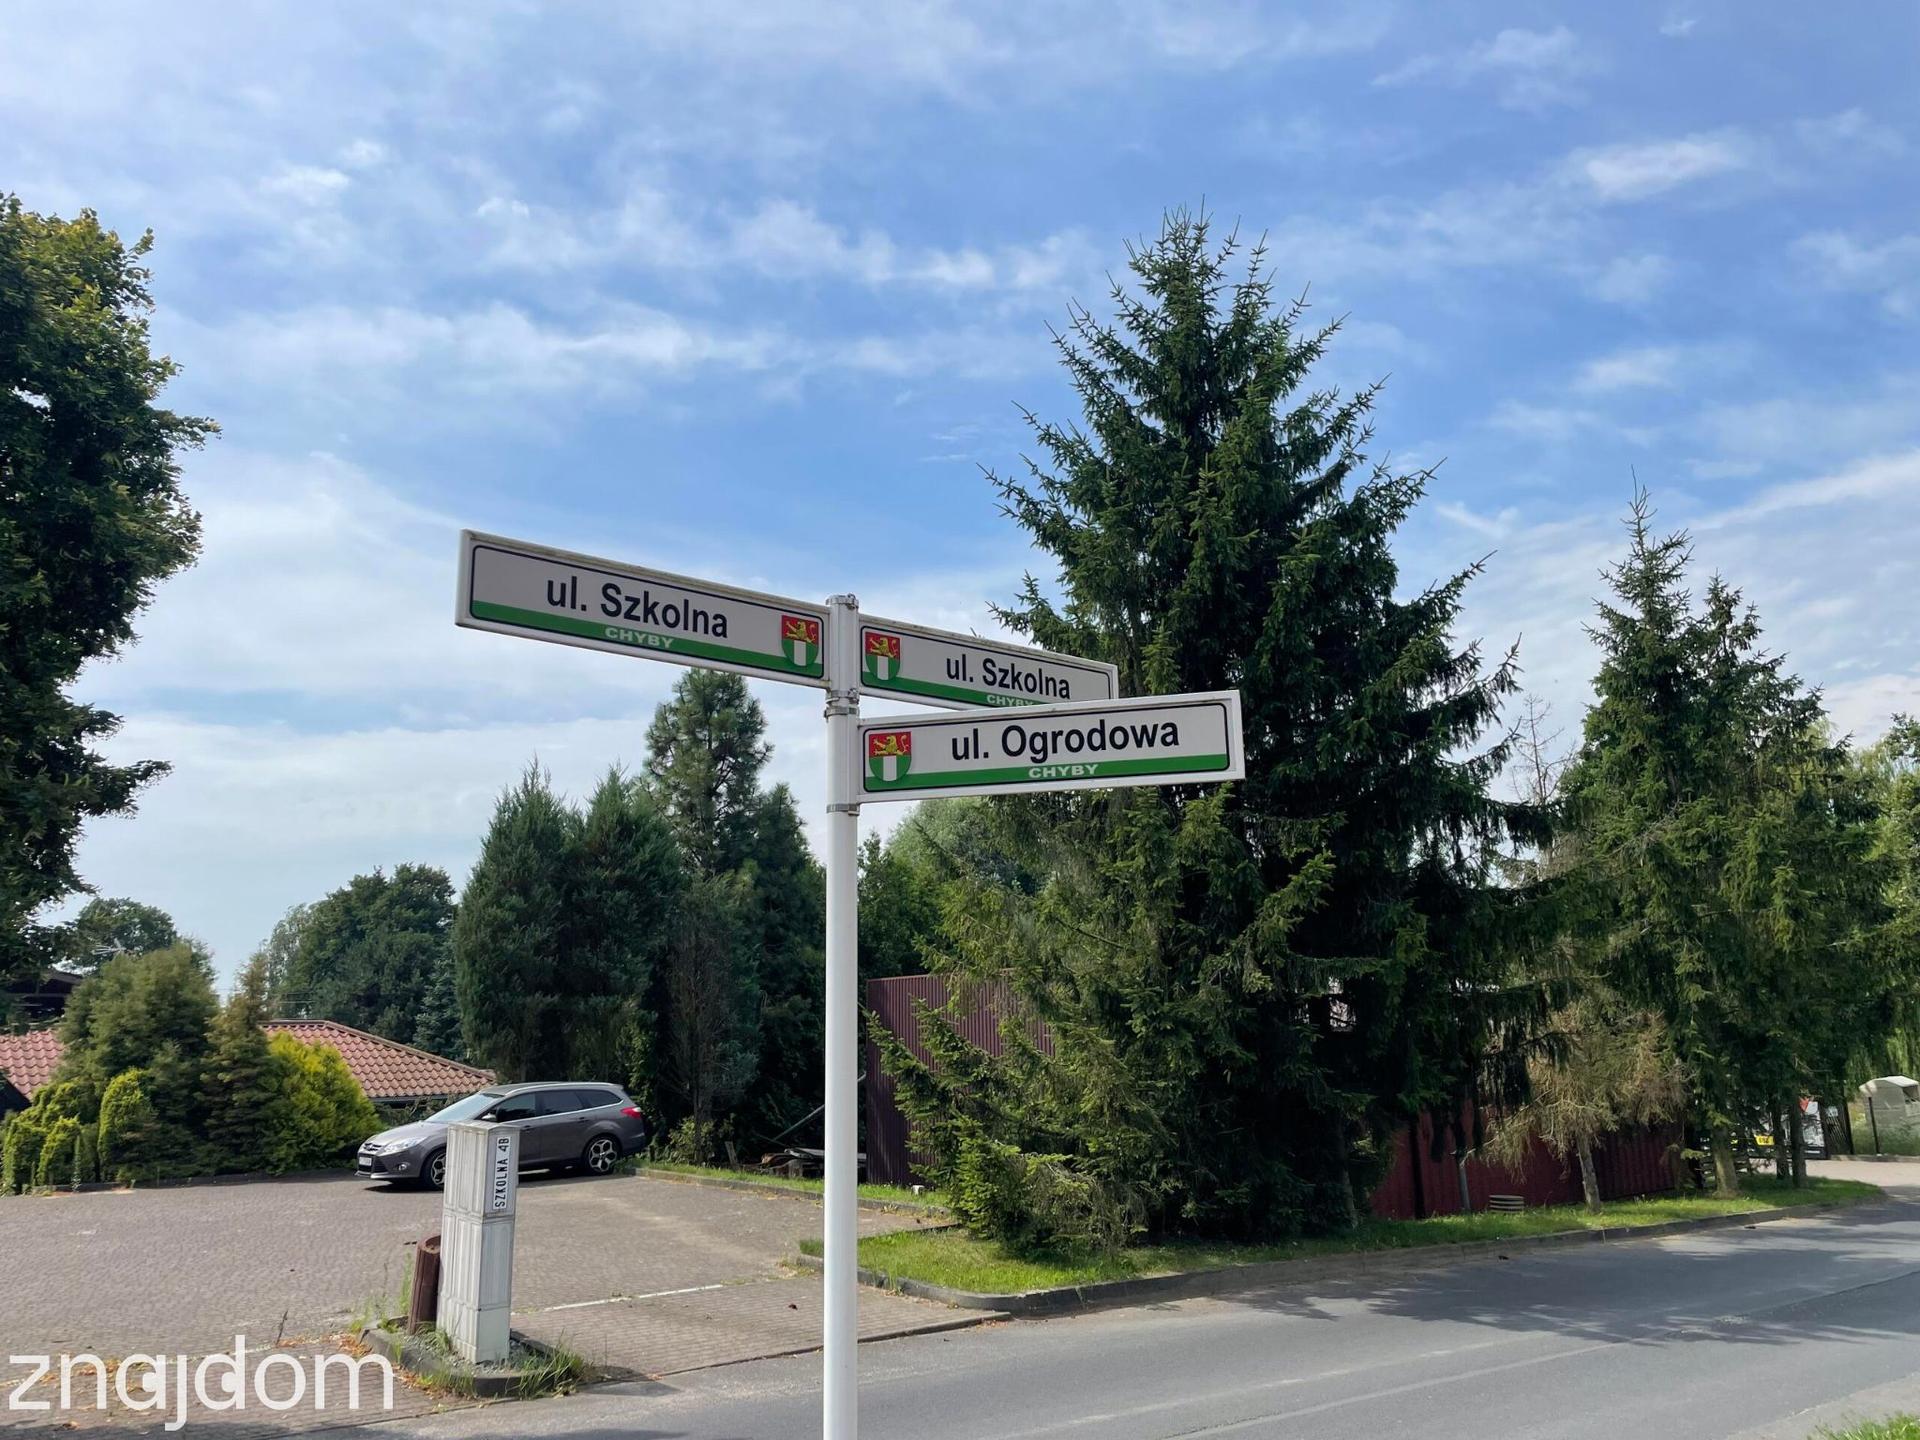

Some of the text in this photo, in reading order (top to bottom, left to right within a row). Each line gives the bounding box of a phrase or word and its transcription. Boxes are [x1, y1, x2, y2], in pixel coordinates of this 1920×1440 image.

[547, 575, 728, 638] ul. Szkolna
[605, 628, 674, 649] CHYBY
[946, 654, 1070, 699] ul. Szkolna
[951, 719, 1179, 763] ul. Ogrodowa
[1028, 764, 1099, 779] CHYBY
[495, 1138, 510, 1208] SZKOLNA 4B
